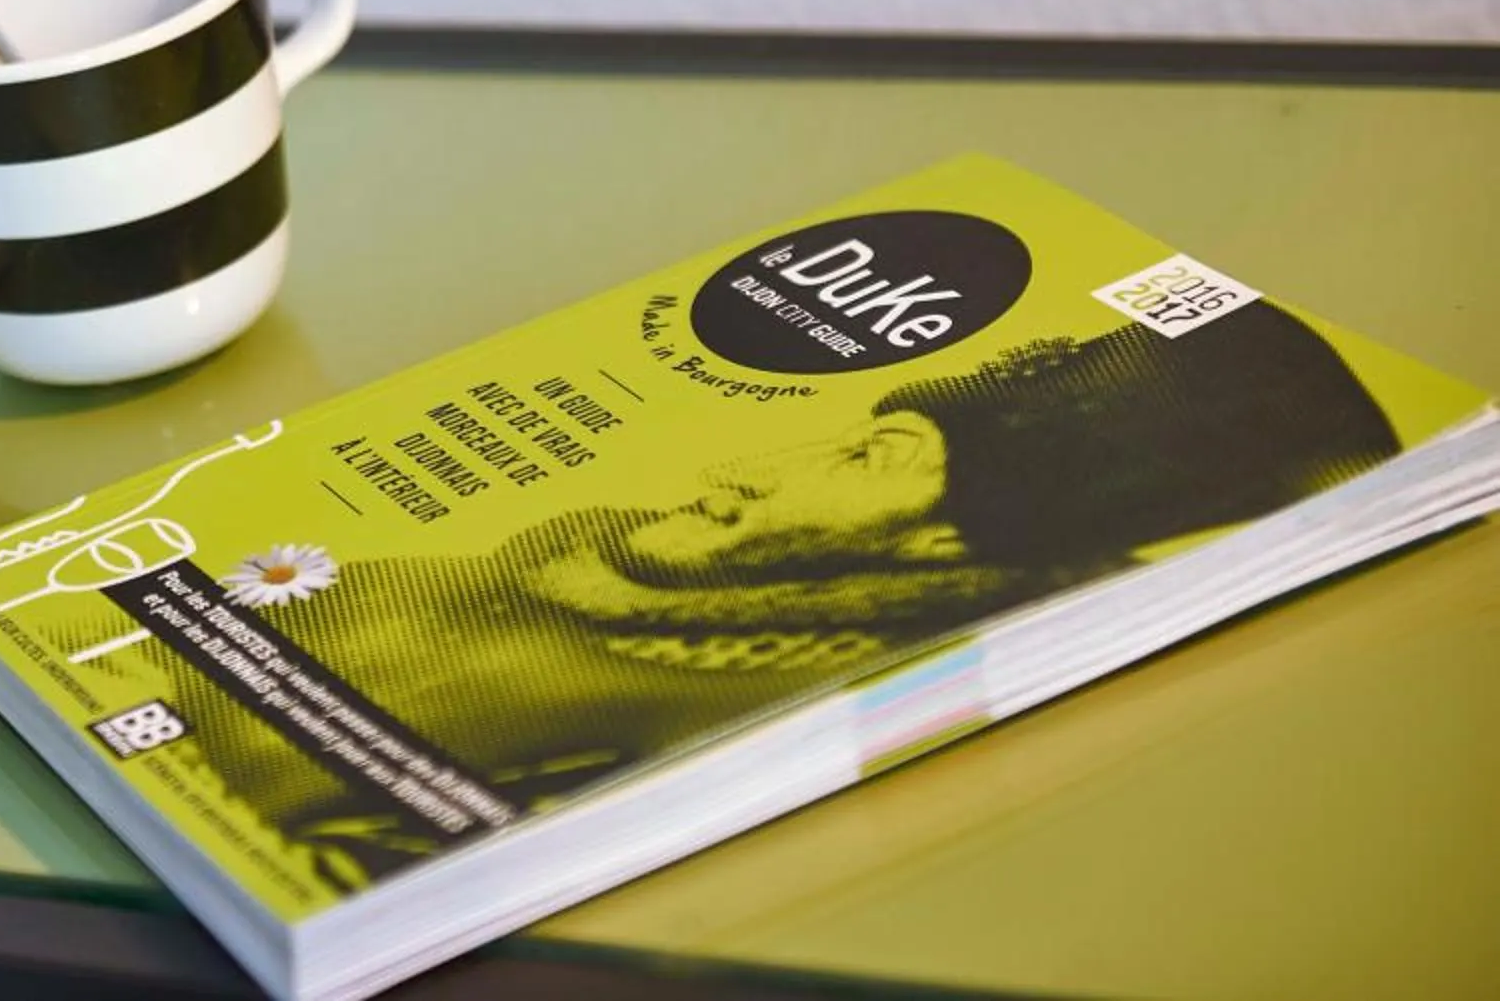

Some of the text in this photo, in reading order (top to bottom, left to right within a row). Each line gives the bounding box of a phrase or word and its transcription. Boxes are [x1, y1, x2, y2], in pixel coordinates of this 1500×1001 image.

[730, 275, 867, 358] DIJON CITY GUIDE
[759, 238, 963, 348] le DuKe
[1112, 283, 1202, 325] 2017
[1149, 266, 1237, 311] 2016
[642, 295, 820, 401] Made in Bourgogne
[466, 381, 596, 469] AVEC DE VRAIS
[533, 375, 624, 435] UN GUIDE
[331, 436, 367, 456] À
[394, 432, 491, 498] DIJONNAIS
[425, 402, 550, 487] MORCEAUX DE
[142, 593, 167, 608] et
[149, 604, 191, 628] pour
[157, 570, 193, 596] Pour
[183, 590, 211, 611] les
[202, 605, 279, 660] TOURISTES
[182, 623, 209, 644] les
[200, 637, 278, 694] DIJONNAIS
